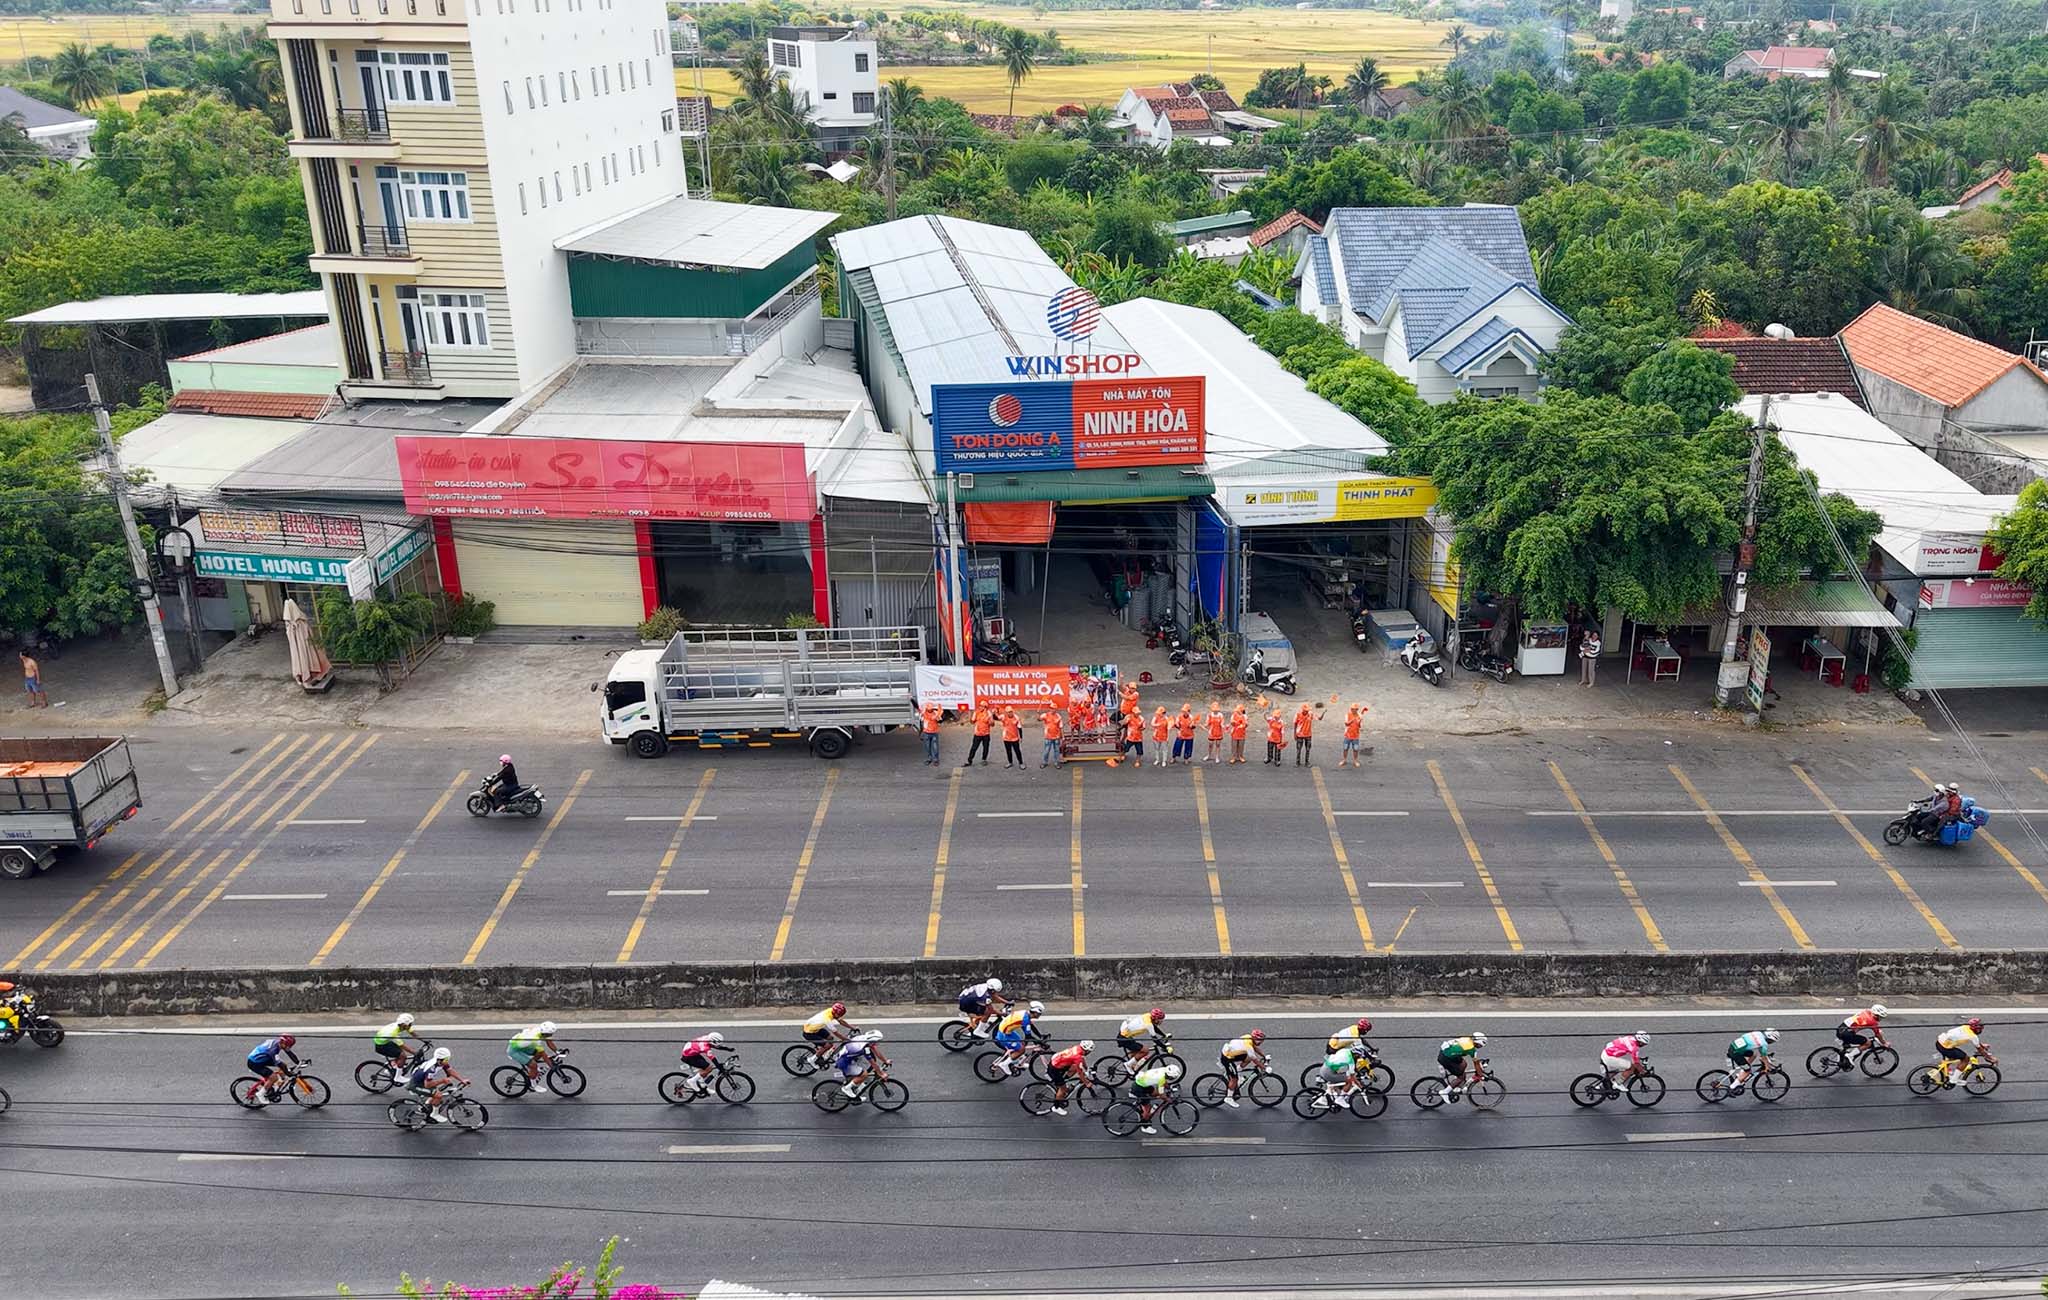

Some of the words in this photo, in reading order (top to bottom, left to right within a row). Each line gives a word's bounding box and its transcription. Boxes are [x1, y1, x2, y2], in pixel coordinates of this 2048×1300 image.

[1005, 354, 1141, 375] WINSHOP
[1103, 388, 1124, 401] NHÀ
[1127, 387, 1148, 400] MÁY
[1152, 386, 1171, 399] TÔN
[1084, 410, 1137, 435] NINH
[1144, 402, 1189, 433] HÒA
[1343, 490, 1380, 502] THỊNH
[1384, 486, 1415, 498] PHÁT
[1922, 548, 1950, 556] TRỌNG
[199, 555, 257, 572] HOTEL
[261, 558, 313, 575] HƯNG
[318, 561, 348, 577] LO
[976, 684, 1019, 696] NINH
[1025, 681, 1064, 696] HÒA
